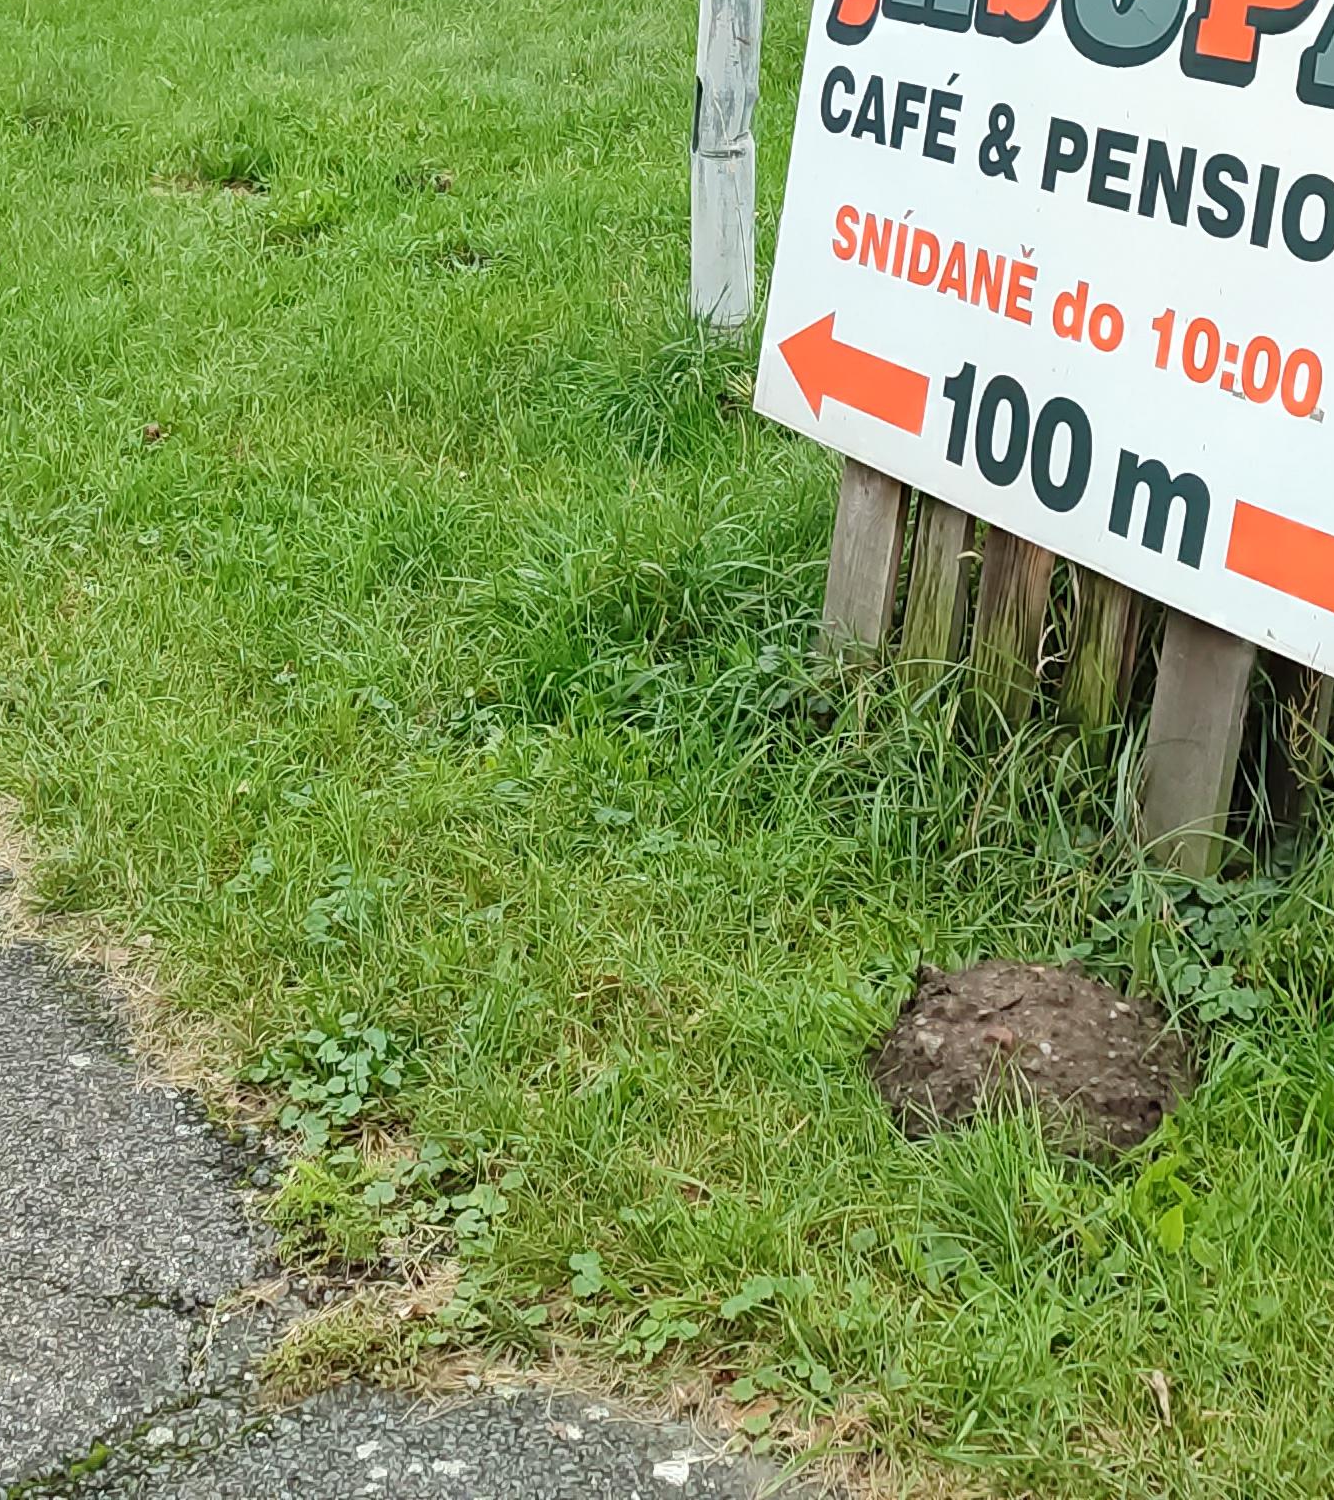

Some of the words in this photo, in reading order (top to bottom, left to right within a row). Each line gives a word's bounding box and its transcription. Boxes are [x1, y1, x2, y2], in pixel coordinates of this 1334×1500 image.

[820, 65, 963, 163] CAFÉ
[977, 102, 1020, 182] &
[832, 204, 1039, 324] SNÍDANĚ
[1052, 281, 1125, 353] do
[1151, 308, 1323, 417] 10:00
[942, 360, 1094, 513] 100
[1107, 447, 1214, 571] m
